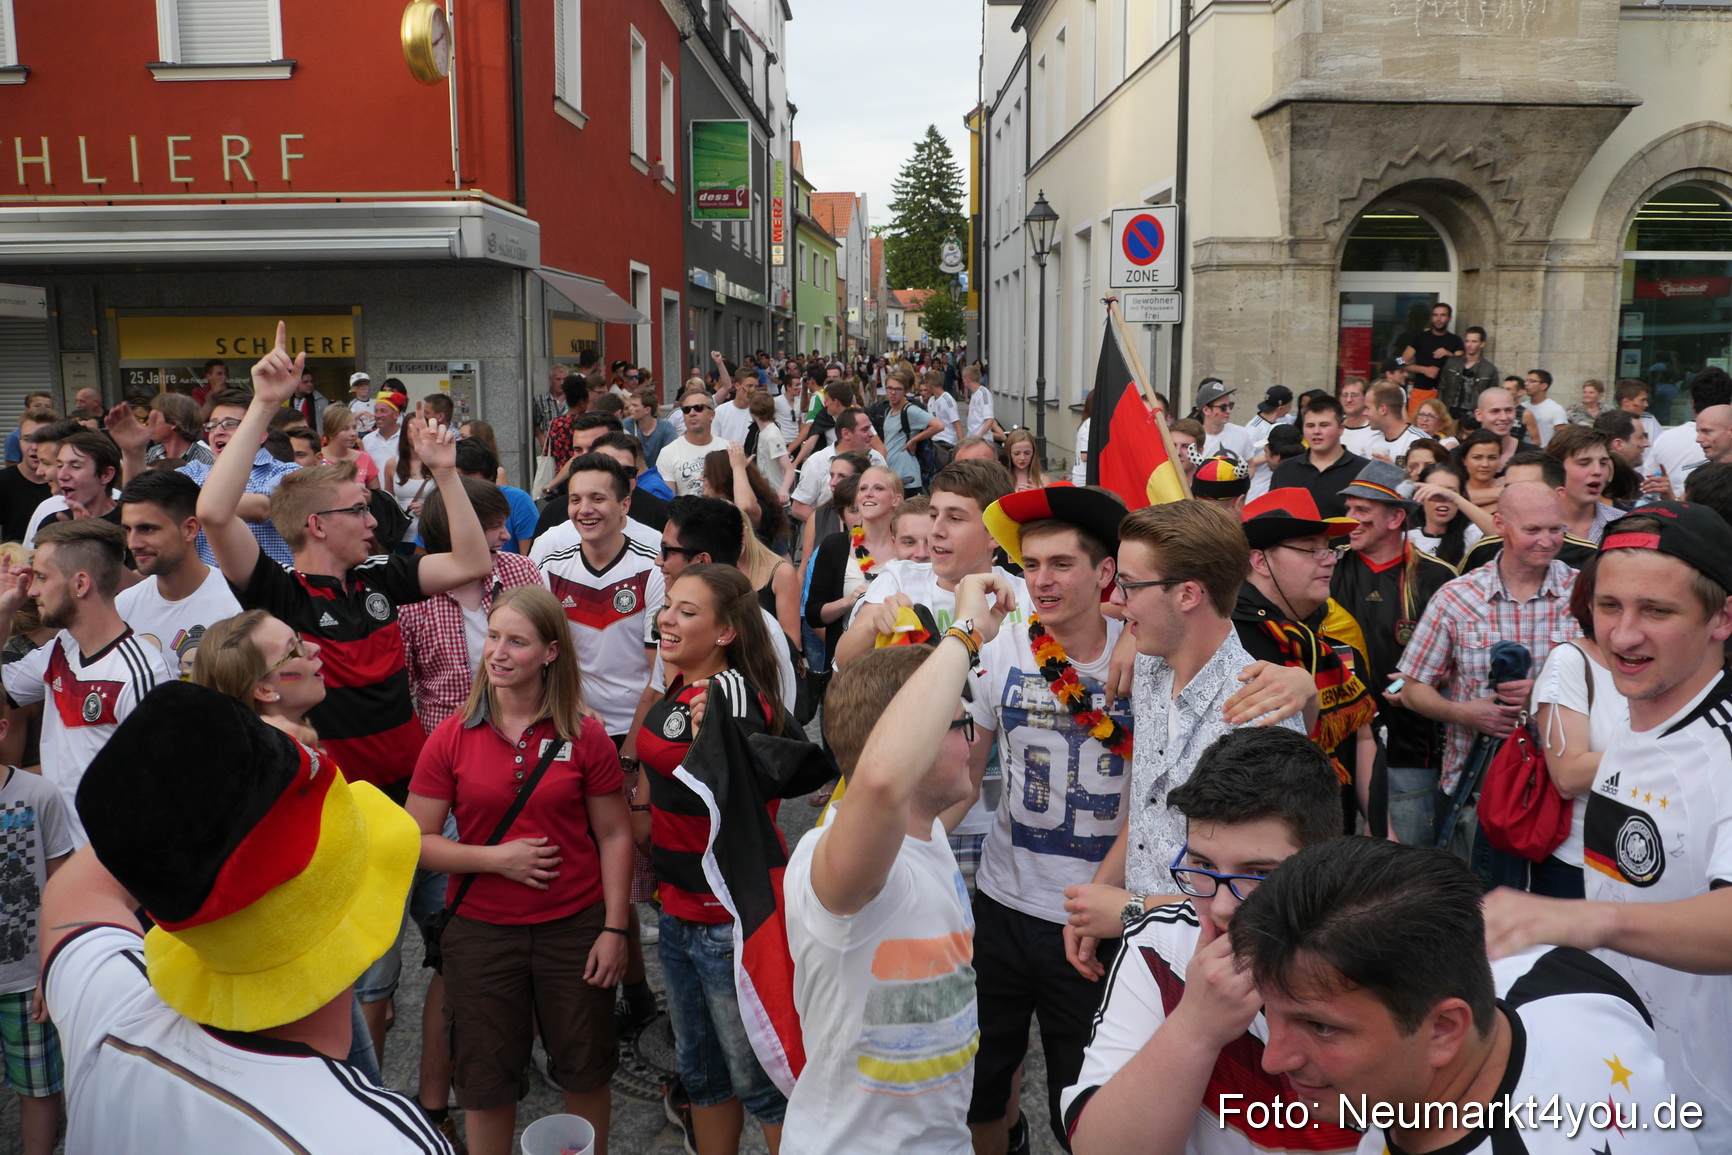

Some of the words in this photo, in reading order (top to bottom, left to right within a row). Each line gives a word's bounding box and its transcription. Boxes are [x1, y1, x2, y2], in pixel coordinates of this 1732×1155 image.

[0, 133, 305, 185] HLIERF
[773, 161, 784, 197] Reisen
[699, 193, 730, 201] dess
[772, 198, 784, 243] MERZ
[1126, 269, 1159, 283] ZONE
[1132, 296, 1174, 305] Bewohner
[1144, 312, 1160, 320] frei
[216, 336, 352, 354] SCHIERF
[130, 371, 144, 385] 25
[147, 371, 176, 385] Jahre
[1008, 725, 1133, 838] 09
